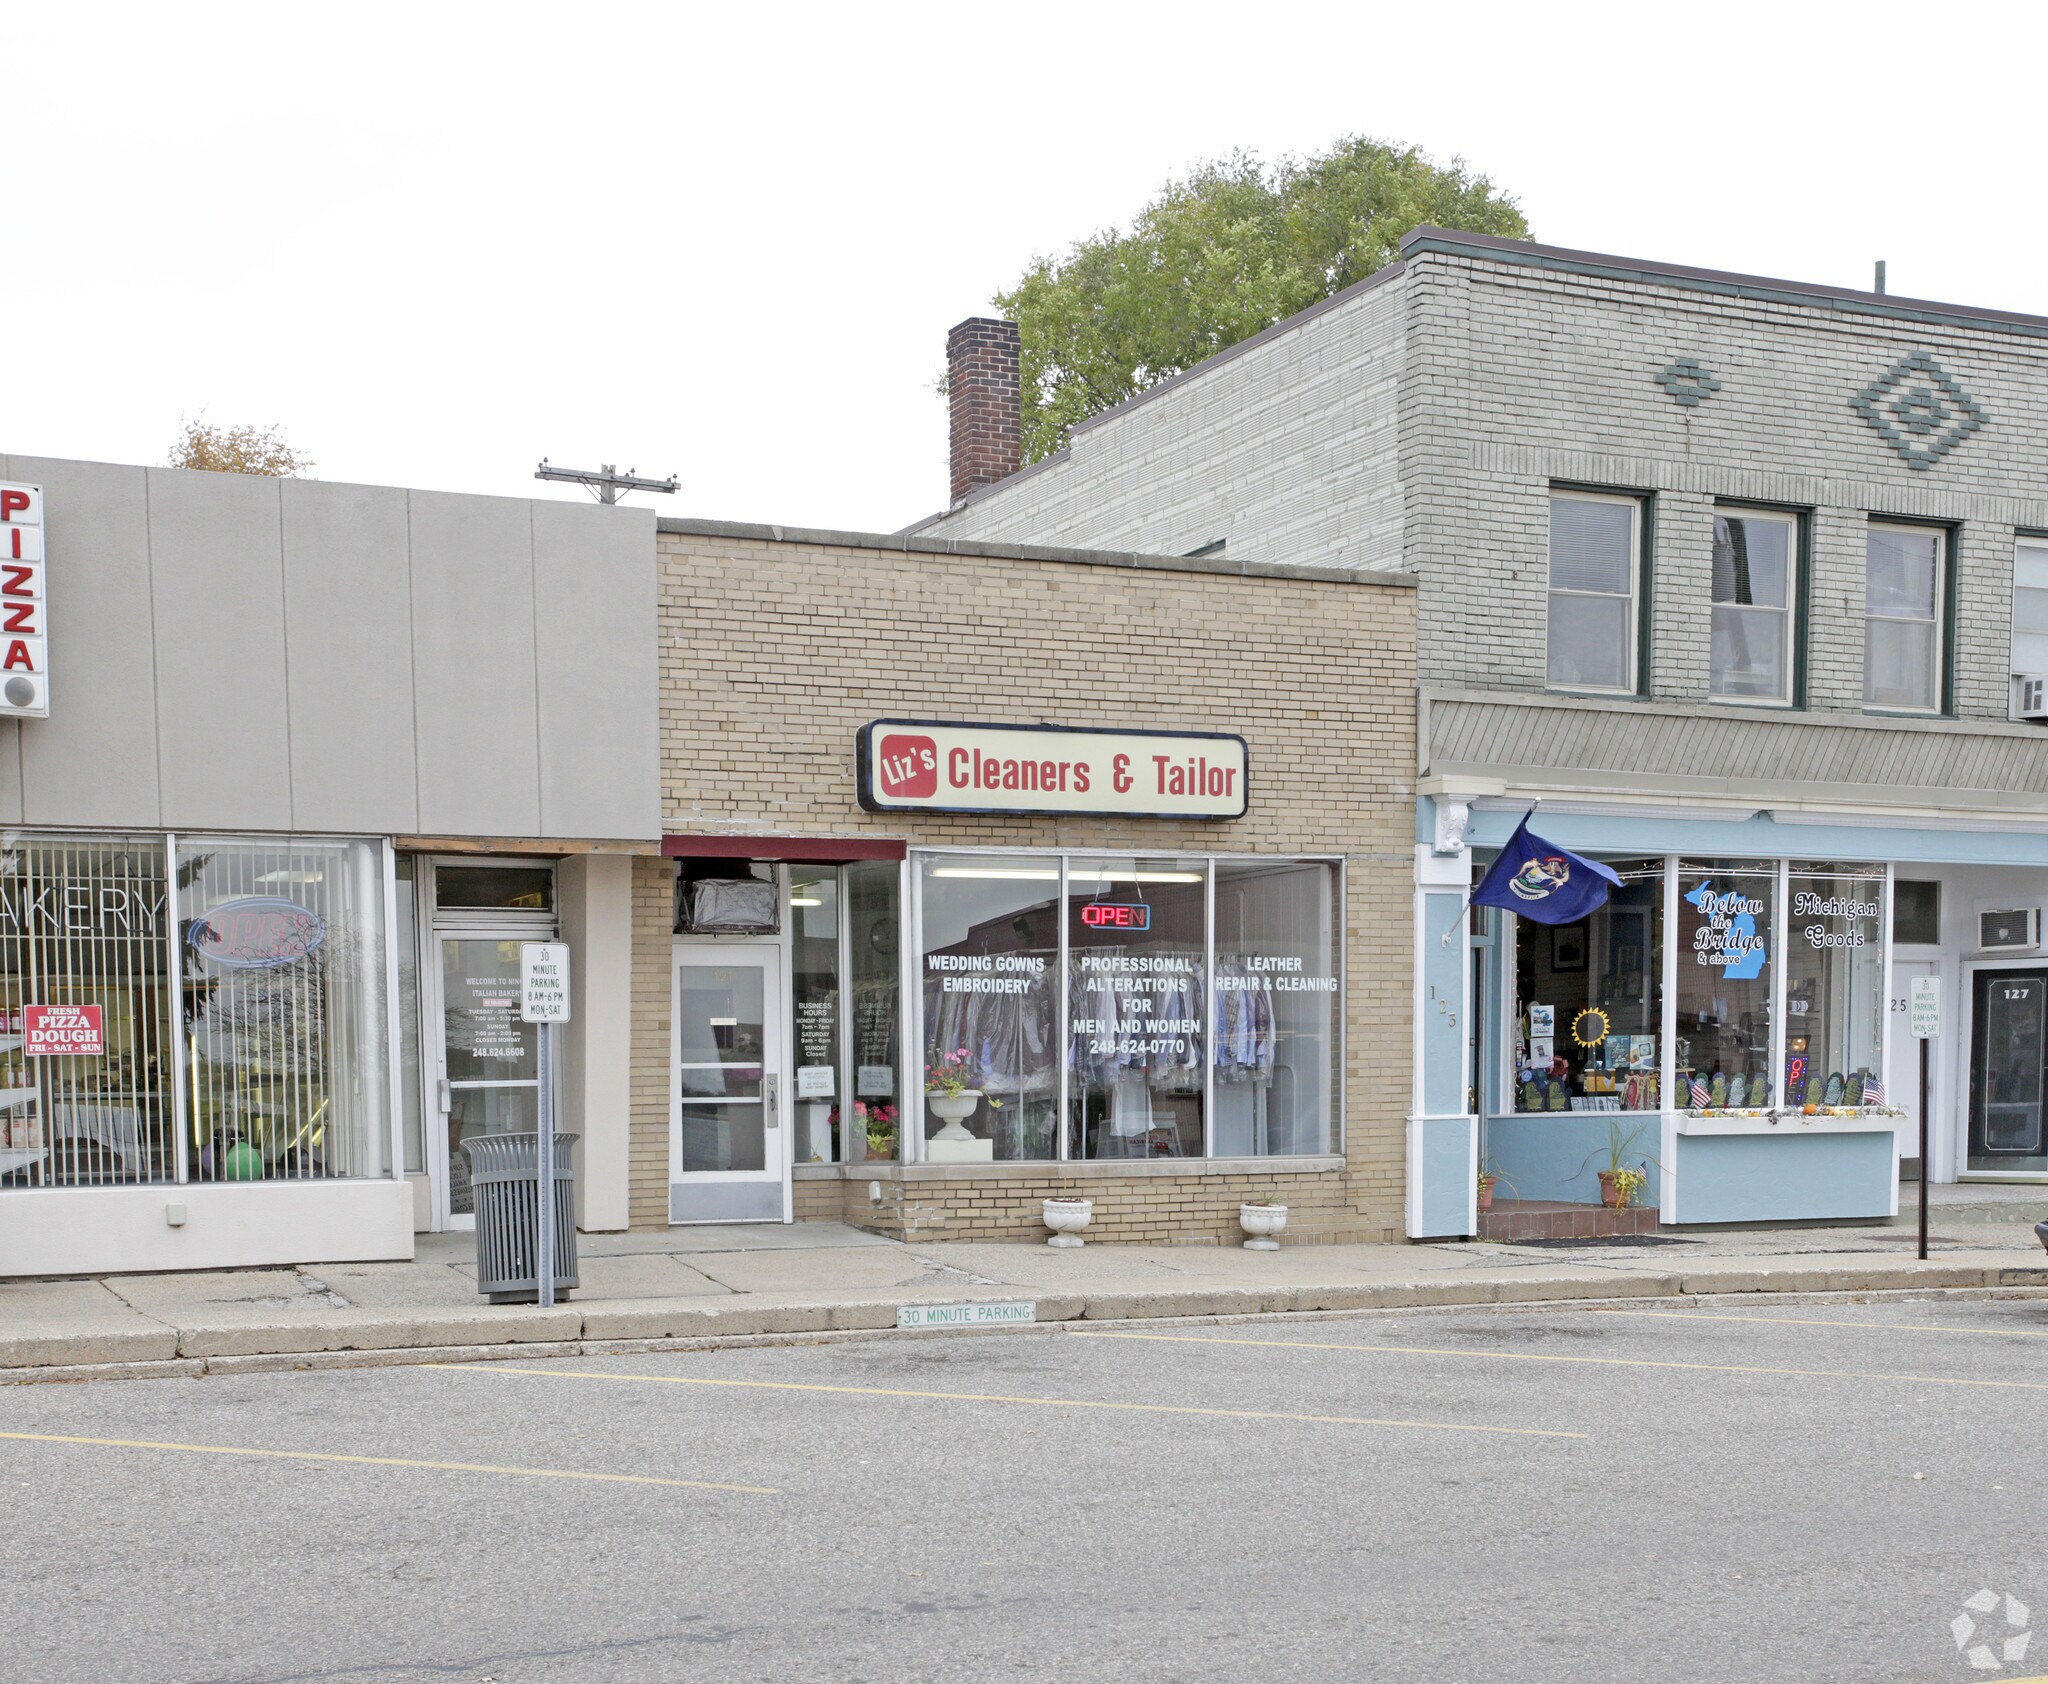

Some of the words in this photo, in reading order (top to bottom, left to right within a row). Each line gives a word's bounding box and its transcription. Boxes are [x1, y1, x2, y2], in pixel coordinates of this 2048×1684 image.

[1, 489, 36, 671] PIZZA
[882, 747, 936, 786] Liz's
[948, 747, 1090, 793] Cleaners
[1113, 753, 1134, 794] &
[1152, 755, 1237, 797] Tailor
[1697, 890, 1764, 915] Below
[1793, 892, 1878, 920] Michigan
[1083, 907, 1146, 926] OPEN
[1711, 914, 1732, 929] the
[1693, 926, 1764, 956] Bridge
[1805, 925, 1865, 948] Goods
[540, 951, 550, 961] 30
[928, 955, 992, 971] WEDDING
[995, 956, 1045, 972] GOWNS
[1697, 952, 1707, 965] &
[1710, 952, 1741, 965] above
[532, 965, 557, 975] MINUTE
[1081, 957, 1194, 972] PROFESSIONAL
[1247, 957, 1302, 972] LEATHER
[465, 977, 497, 985] WELCOME
[530, 978, 560, 988] PARKING
[943, 977, 1031, 994] EMBROIDERY
[1086, 977, 1188, 993] ALTERATIONS
[1215, 976, 1260, 991] REPAIR
[1263, 976, 1273, 991] &
[1275, 977, 1338, 992] CLEANING
[1922, 982, 1930, 991] 30
[472, 989, 497, 997] ITALIAN
[498, 989, 521, 997] BAKER
[553, 992, 563, 1001] PM
[1915, 992, 1936, 1001] MINUTE
[2003, 989, 2030, 1000] 127
[47, 1007, 81, 1015] FRESH
[530, 1005, 561, 1015] MON-SAT
[1122, 998, 1152, 1013] FOR
[1914, 1003, 1937, 1012] PARKING
[38, 1015, 91, 1029] PIZZA
[1073, 1019, 1106, 1034] MEN
[1110, 1019, 1142, 1034] AND
[1145, 1019, 1200, 1034] WOMEN
[31, 1029, 99, 1043] DOUGH
[29, 1044, 46, 1052] FRI
[53, 1043, 73, 1052] SAT
[80, 1043, 101, 1051] SUN
[472, 1047, 525, 1058] 248.624.6608
[1089, 1039, 1185, 1054] 248-624-0770
[1785, 1059, 1803, 1104] OPEN
[903, 1310, 920, 1324] 30
[926, 1307, 971, 1323] MINUTE
[978, 1305, 1031, 1321] PARKING
